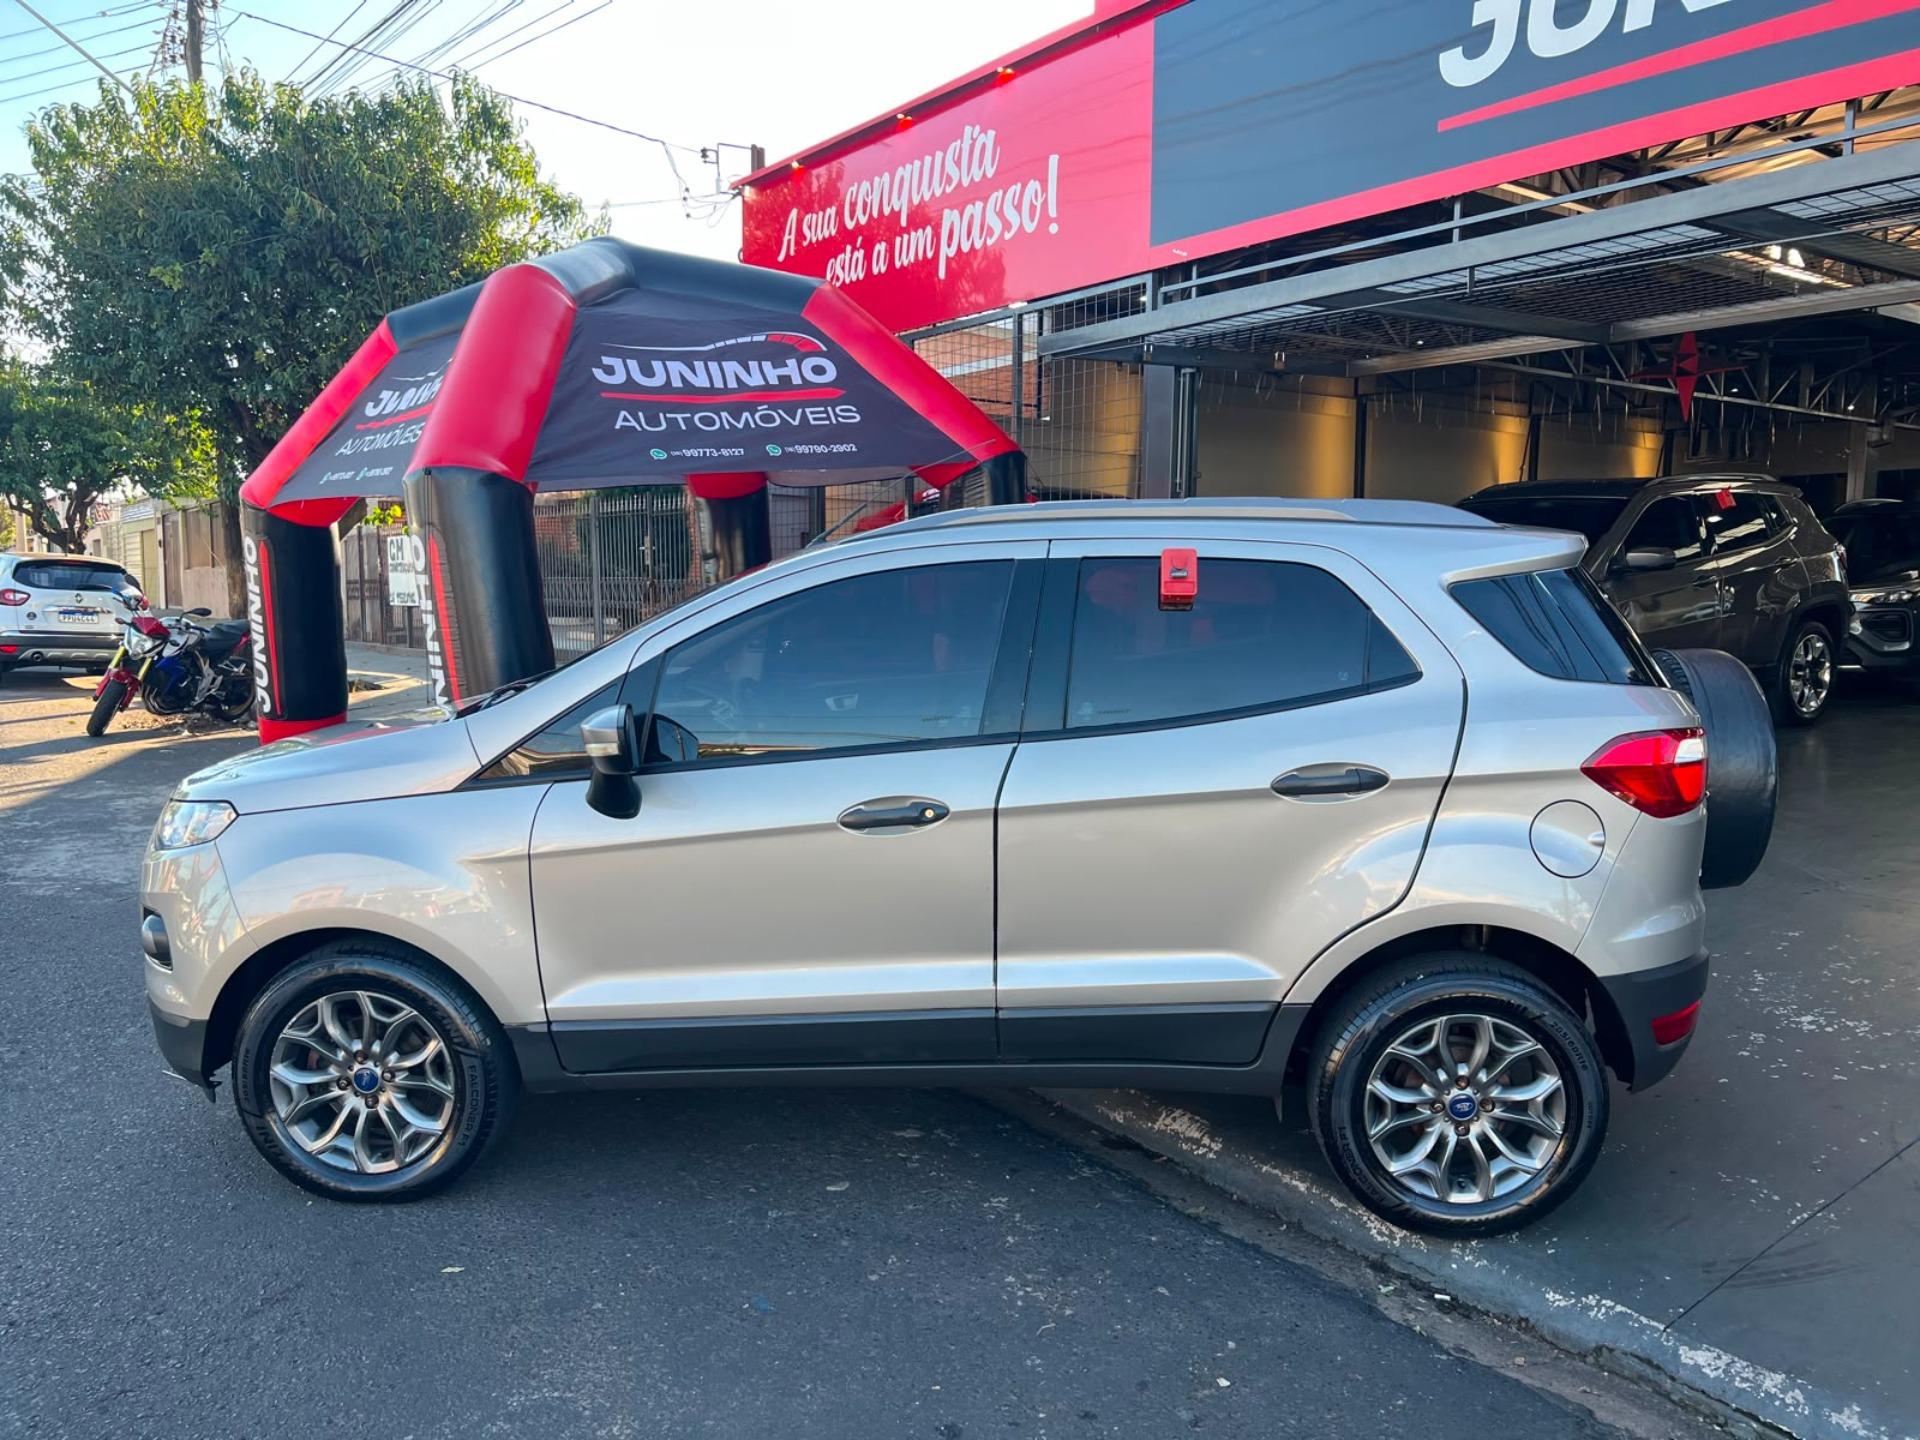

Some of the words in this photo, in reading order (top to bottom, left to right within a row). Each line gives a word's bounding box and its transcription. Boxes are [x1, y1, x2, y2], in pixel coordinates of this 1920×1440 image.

[777, 207, 799, 263] A
[801, 204, 839, 248] sua
[843, 124, 1001, 230] conquista
[825, 236, 867, 288] está
[871, 244, 890, 276] a
[893, 223, 938, 270] um
[937, 154, 1061, 280] passo!
[591, 355, 838, 389] JUNINHO
[614, 404, 862, 432] AUTOMÓVEIS
[242, 535, 272, 714] JUNINHO
